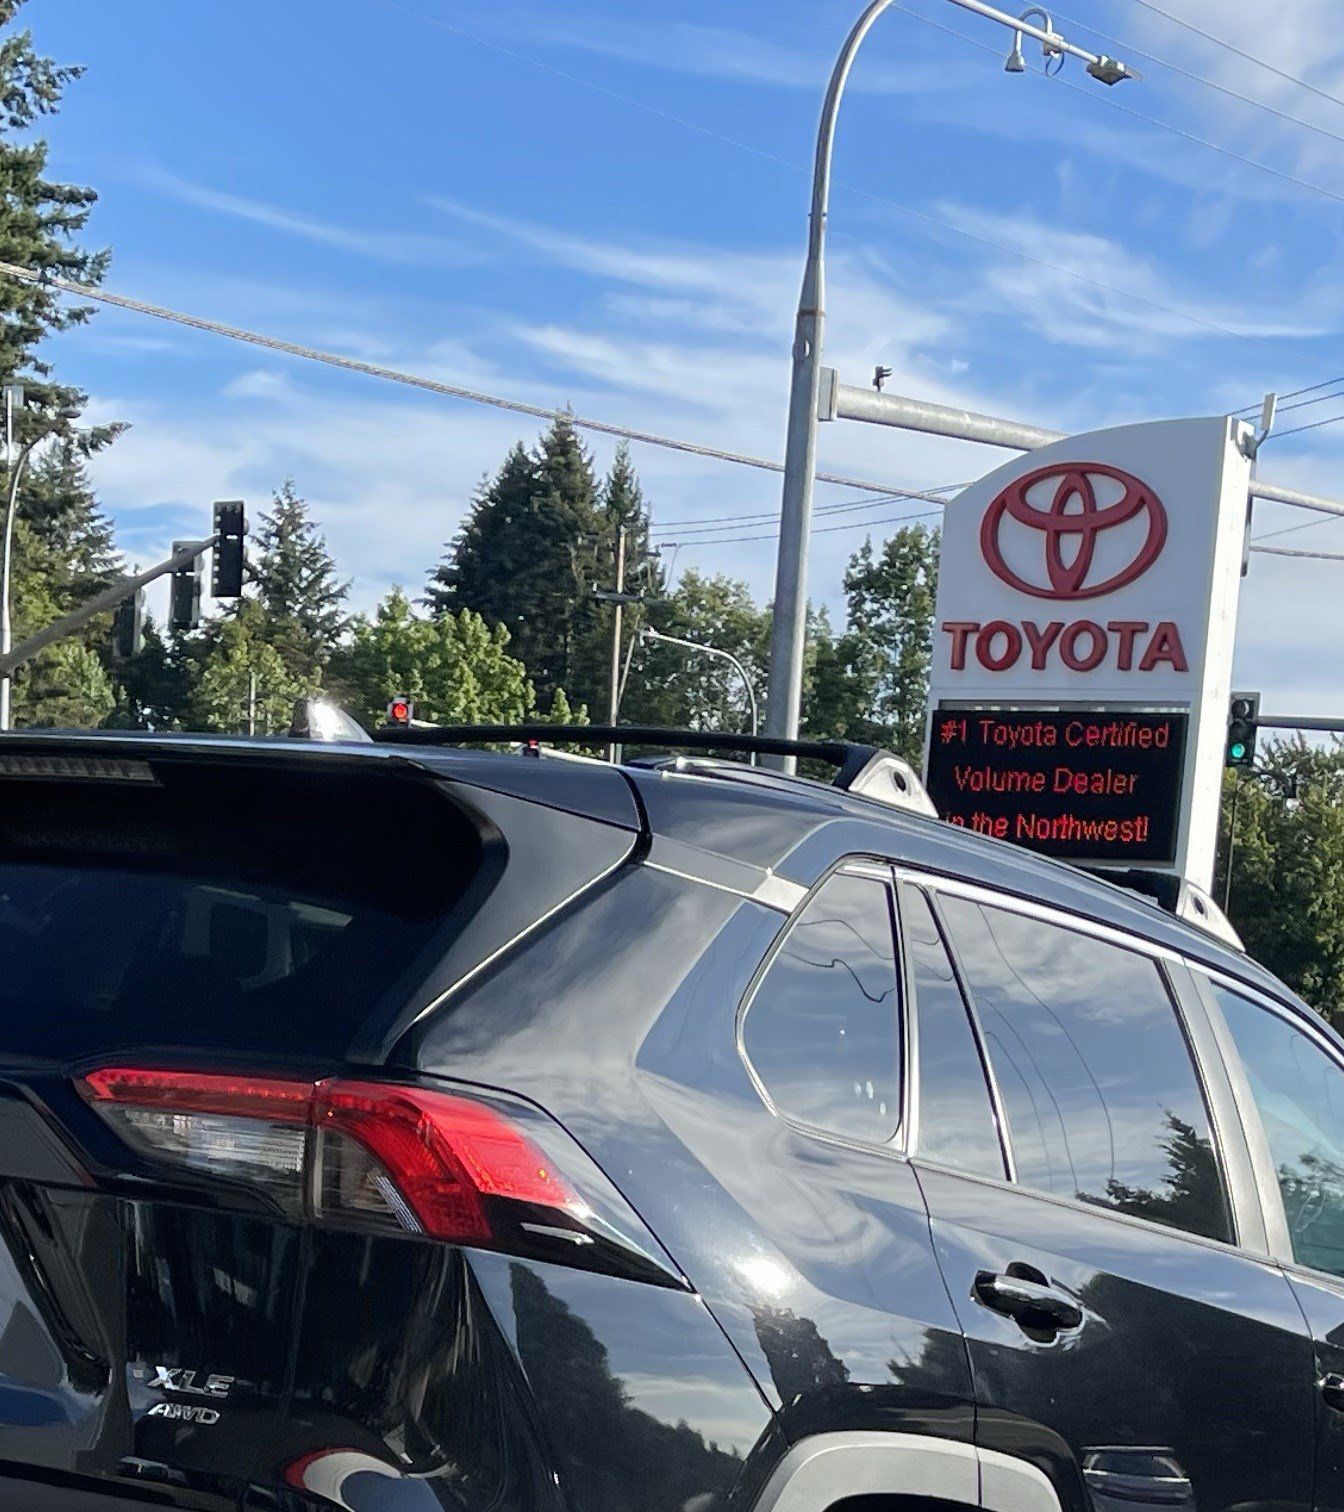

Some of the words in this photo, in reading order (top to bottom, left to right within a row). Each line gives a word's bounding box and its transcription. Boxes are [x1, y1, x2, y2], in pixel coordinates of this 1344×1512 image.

[942, 620, 1189, 673] TOYOTA
[940, 719, 967, 744] #1
[979, 720, 1057, 749] Toyota
[1065, 721, 1170, 749] Certified
[955, 765, 1046, 793] Volume
[1053, 767, 1139, 794] Dealer
[971, 811, 1008, 838] the
[1016, 813, 1150, 843] Northwest!
[147, 1365, 235, 1399] XLE
[147, 1403, 221, 1425] AWD
